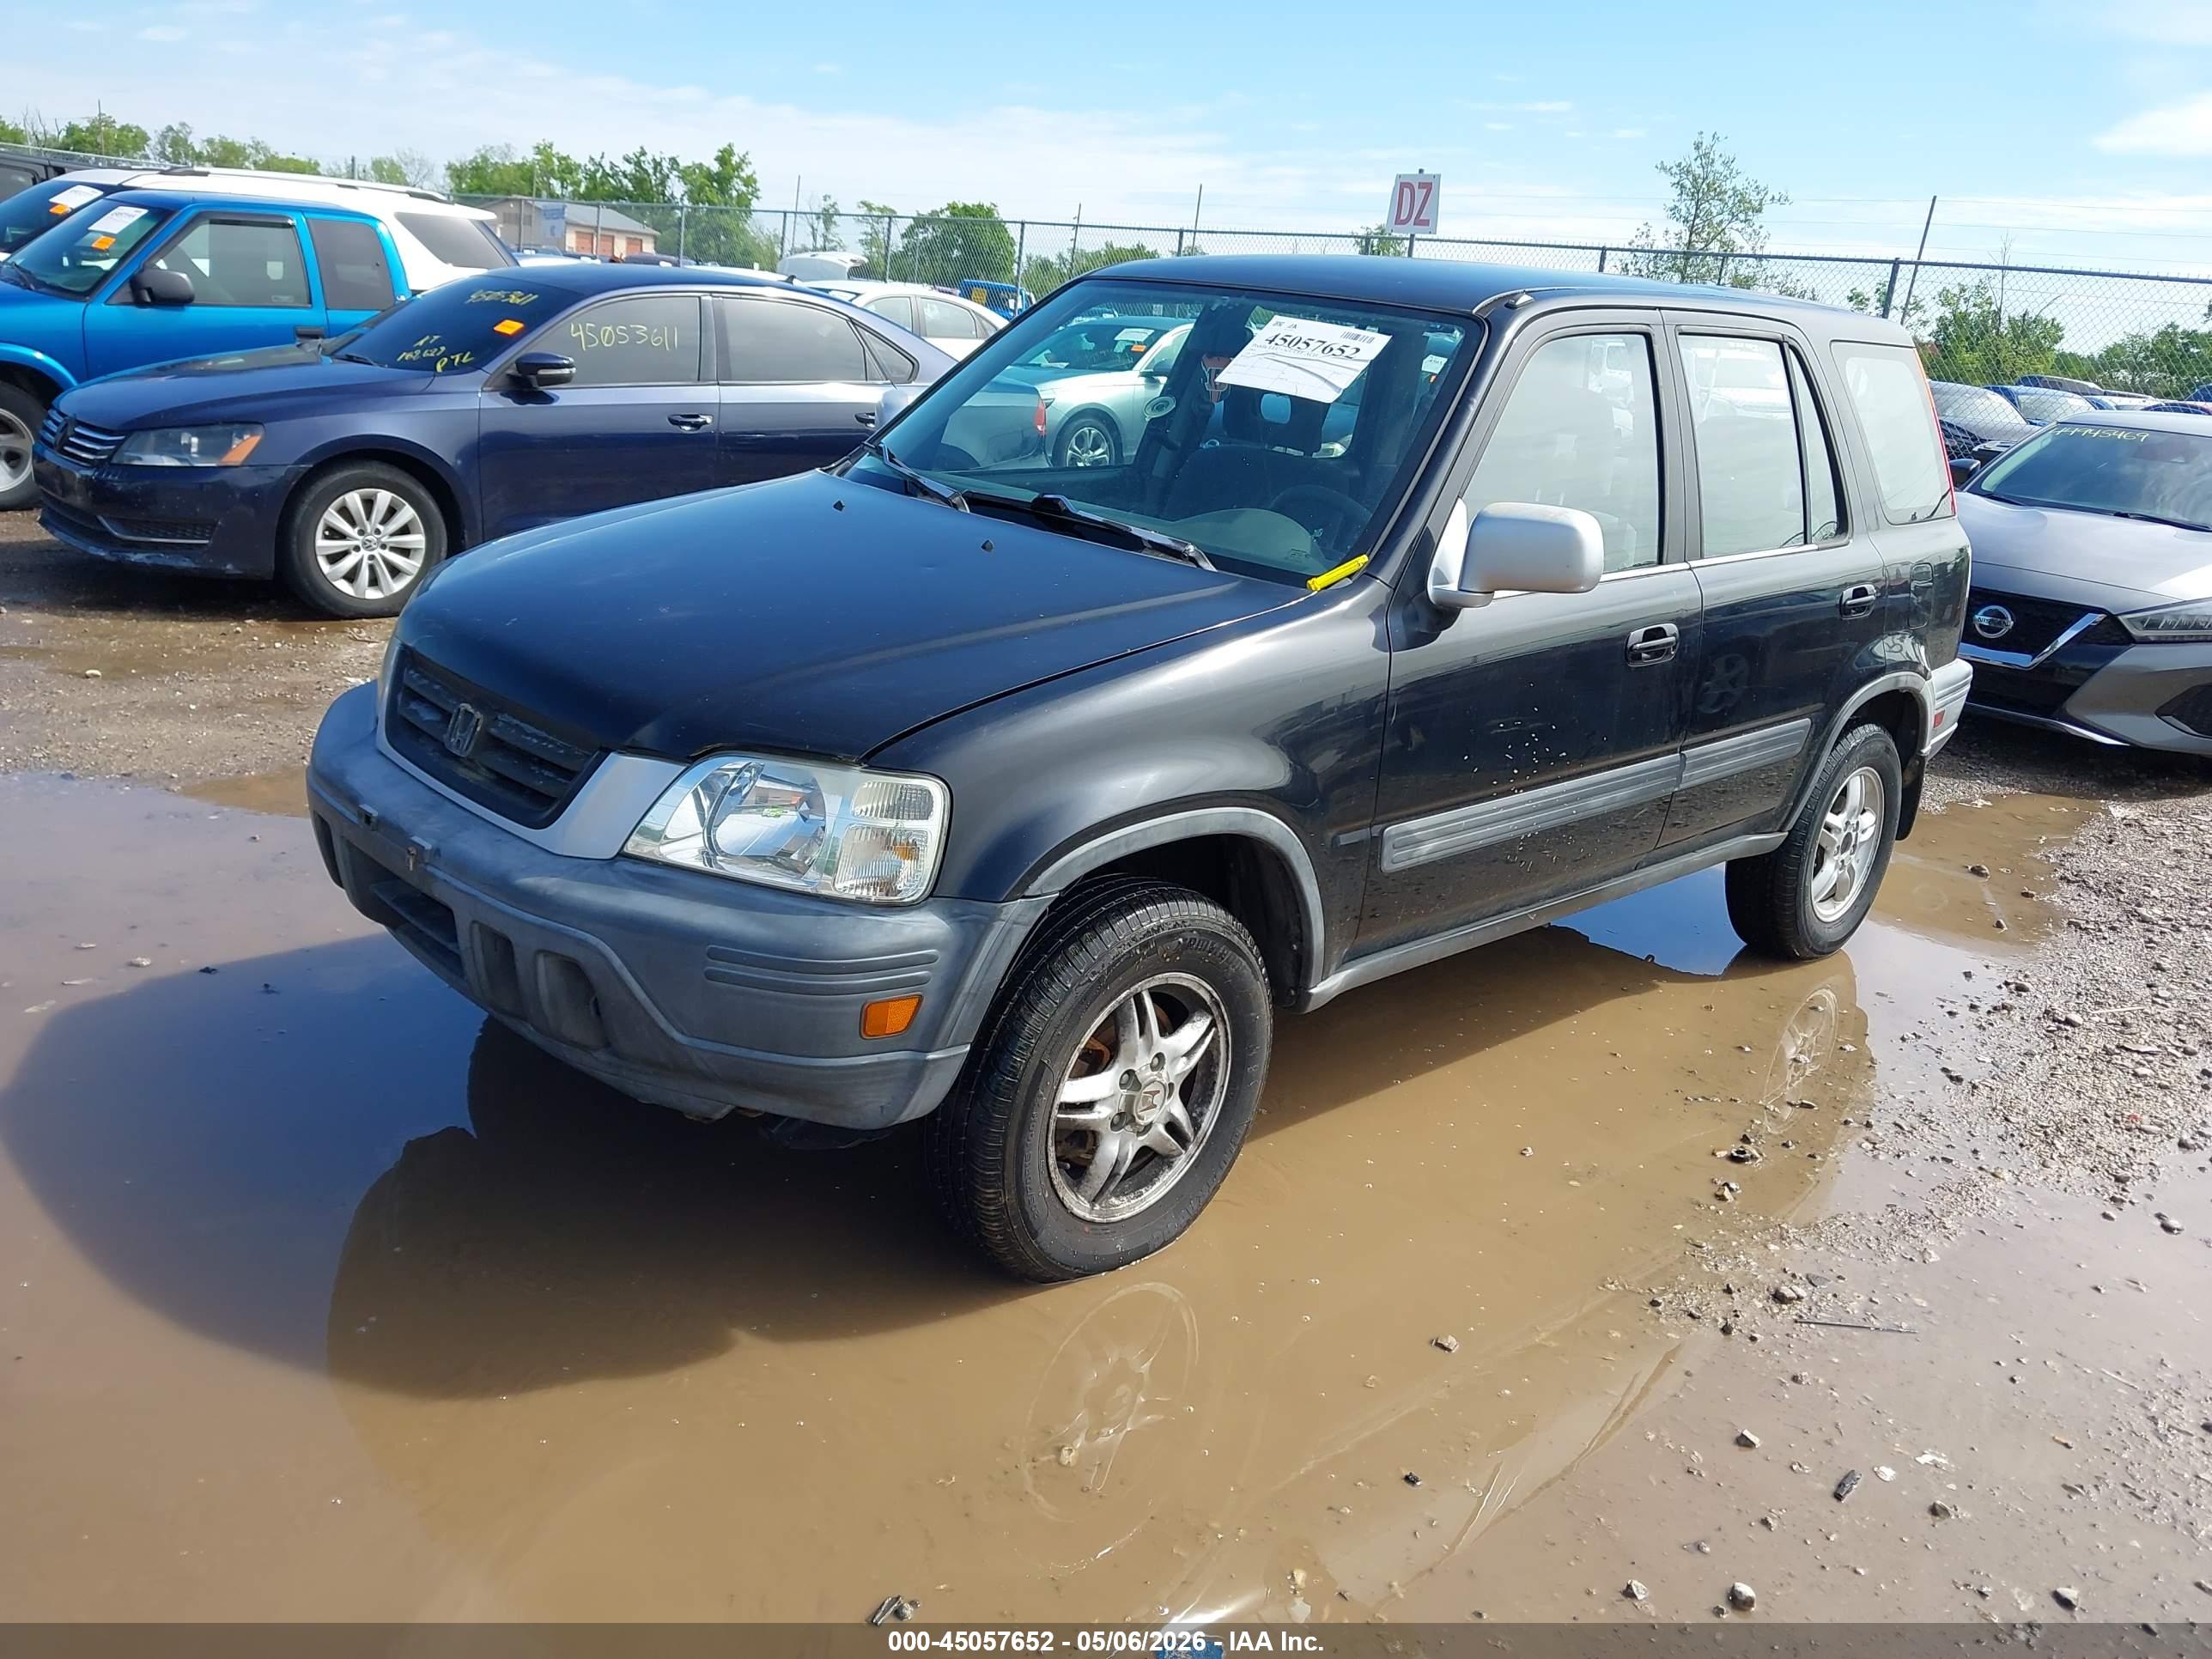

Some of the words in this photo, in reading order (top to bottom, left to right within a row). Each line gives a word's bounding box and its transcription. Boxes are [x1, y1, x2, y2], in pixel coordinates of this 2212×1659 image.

[1394, 181, 1433, 227] DZ
[570, 322, 678, 351] 45053611
[1264, 332, 1361, 360] 45057652
